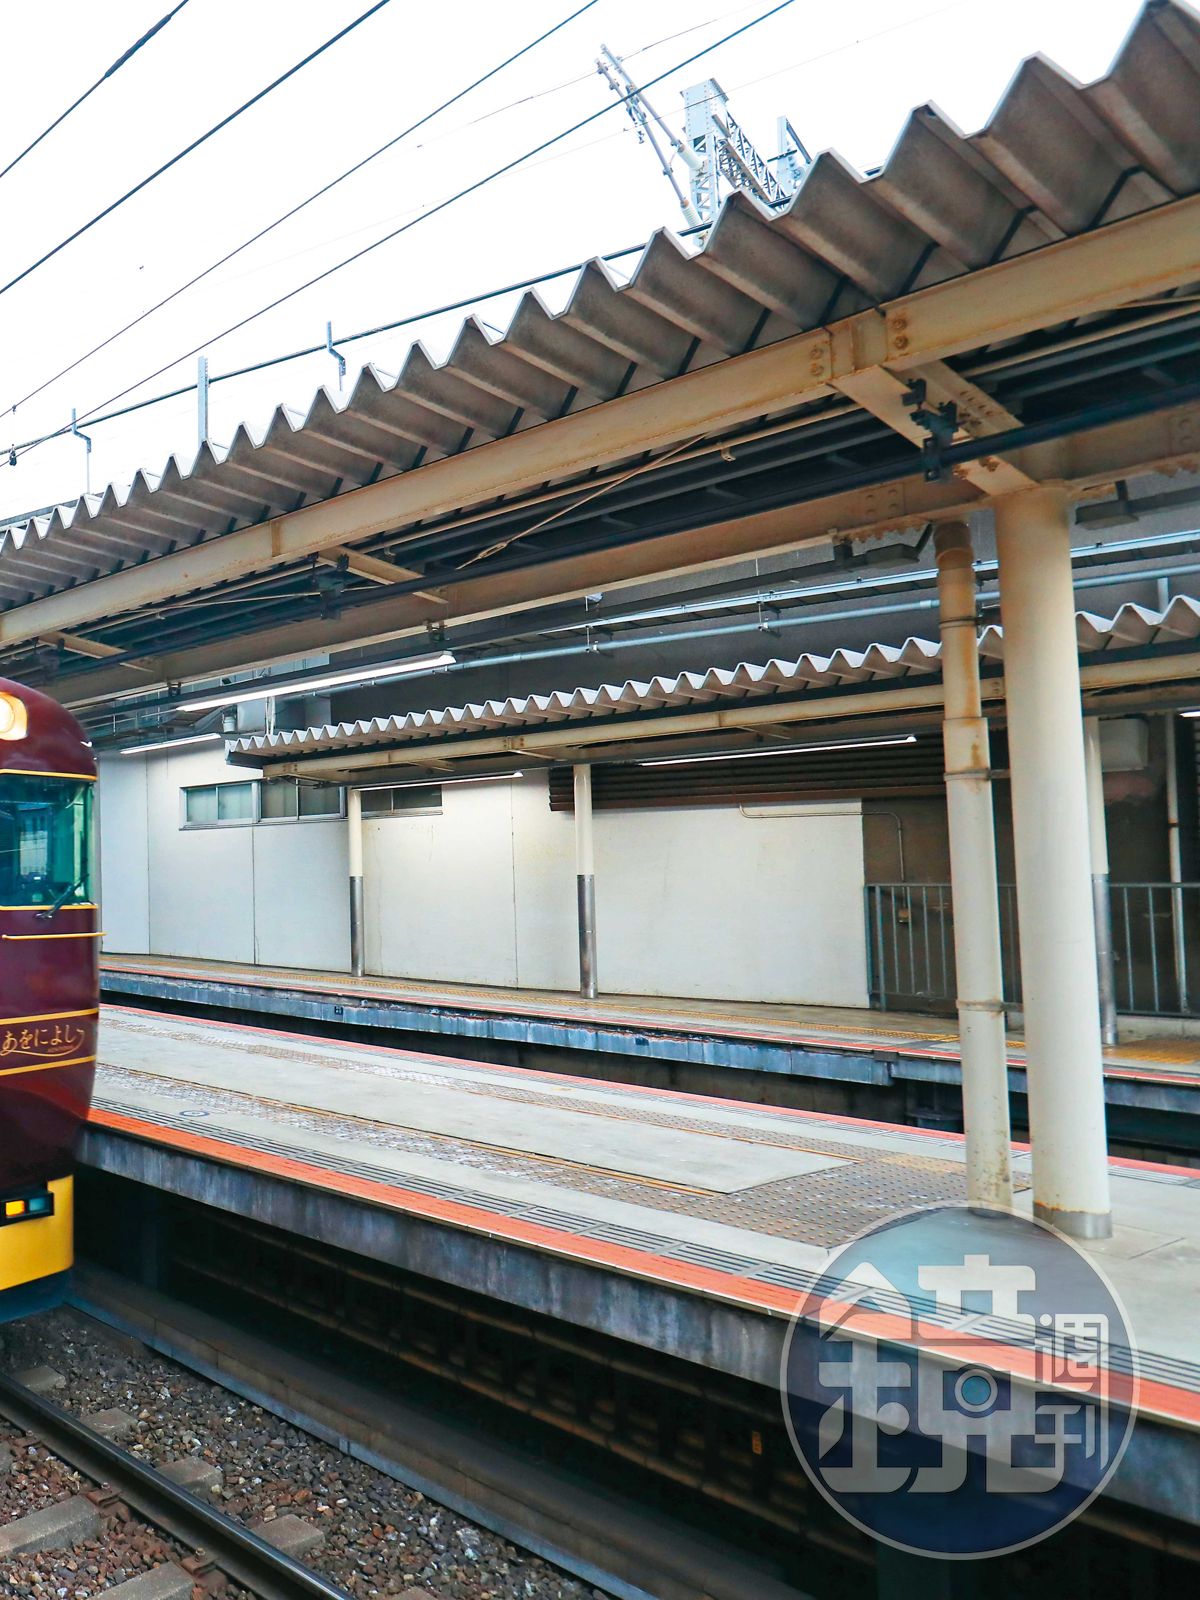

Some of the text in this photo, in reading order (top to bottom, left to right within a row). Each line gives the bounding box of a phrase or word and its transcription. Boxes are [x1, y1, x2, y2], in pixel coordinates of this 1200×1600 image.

[0, 1024, 84, 1057] あをによし
